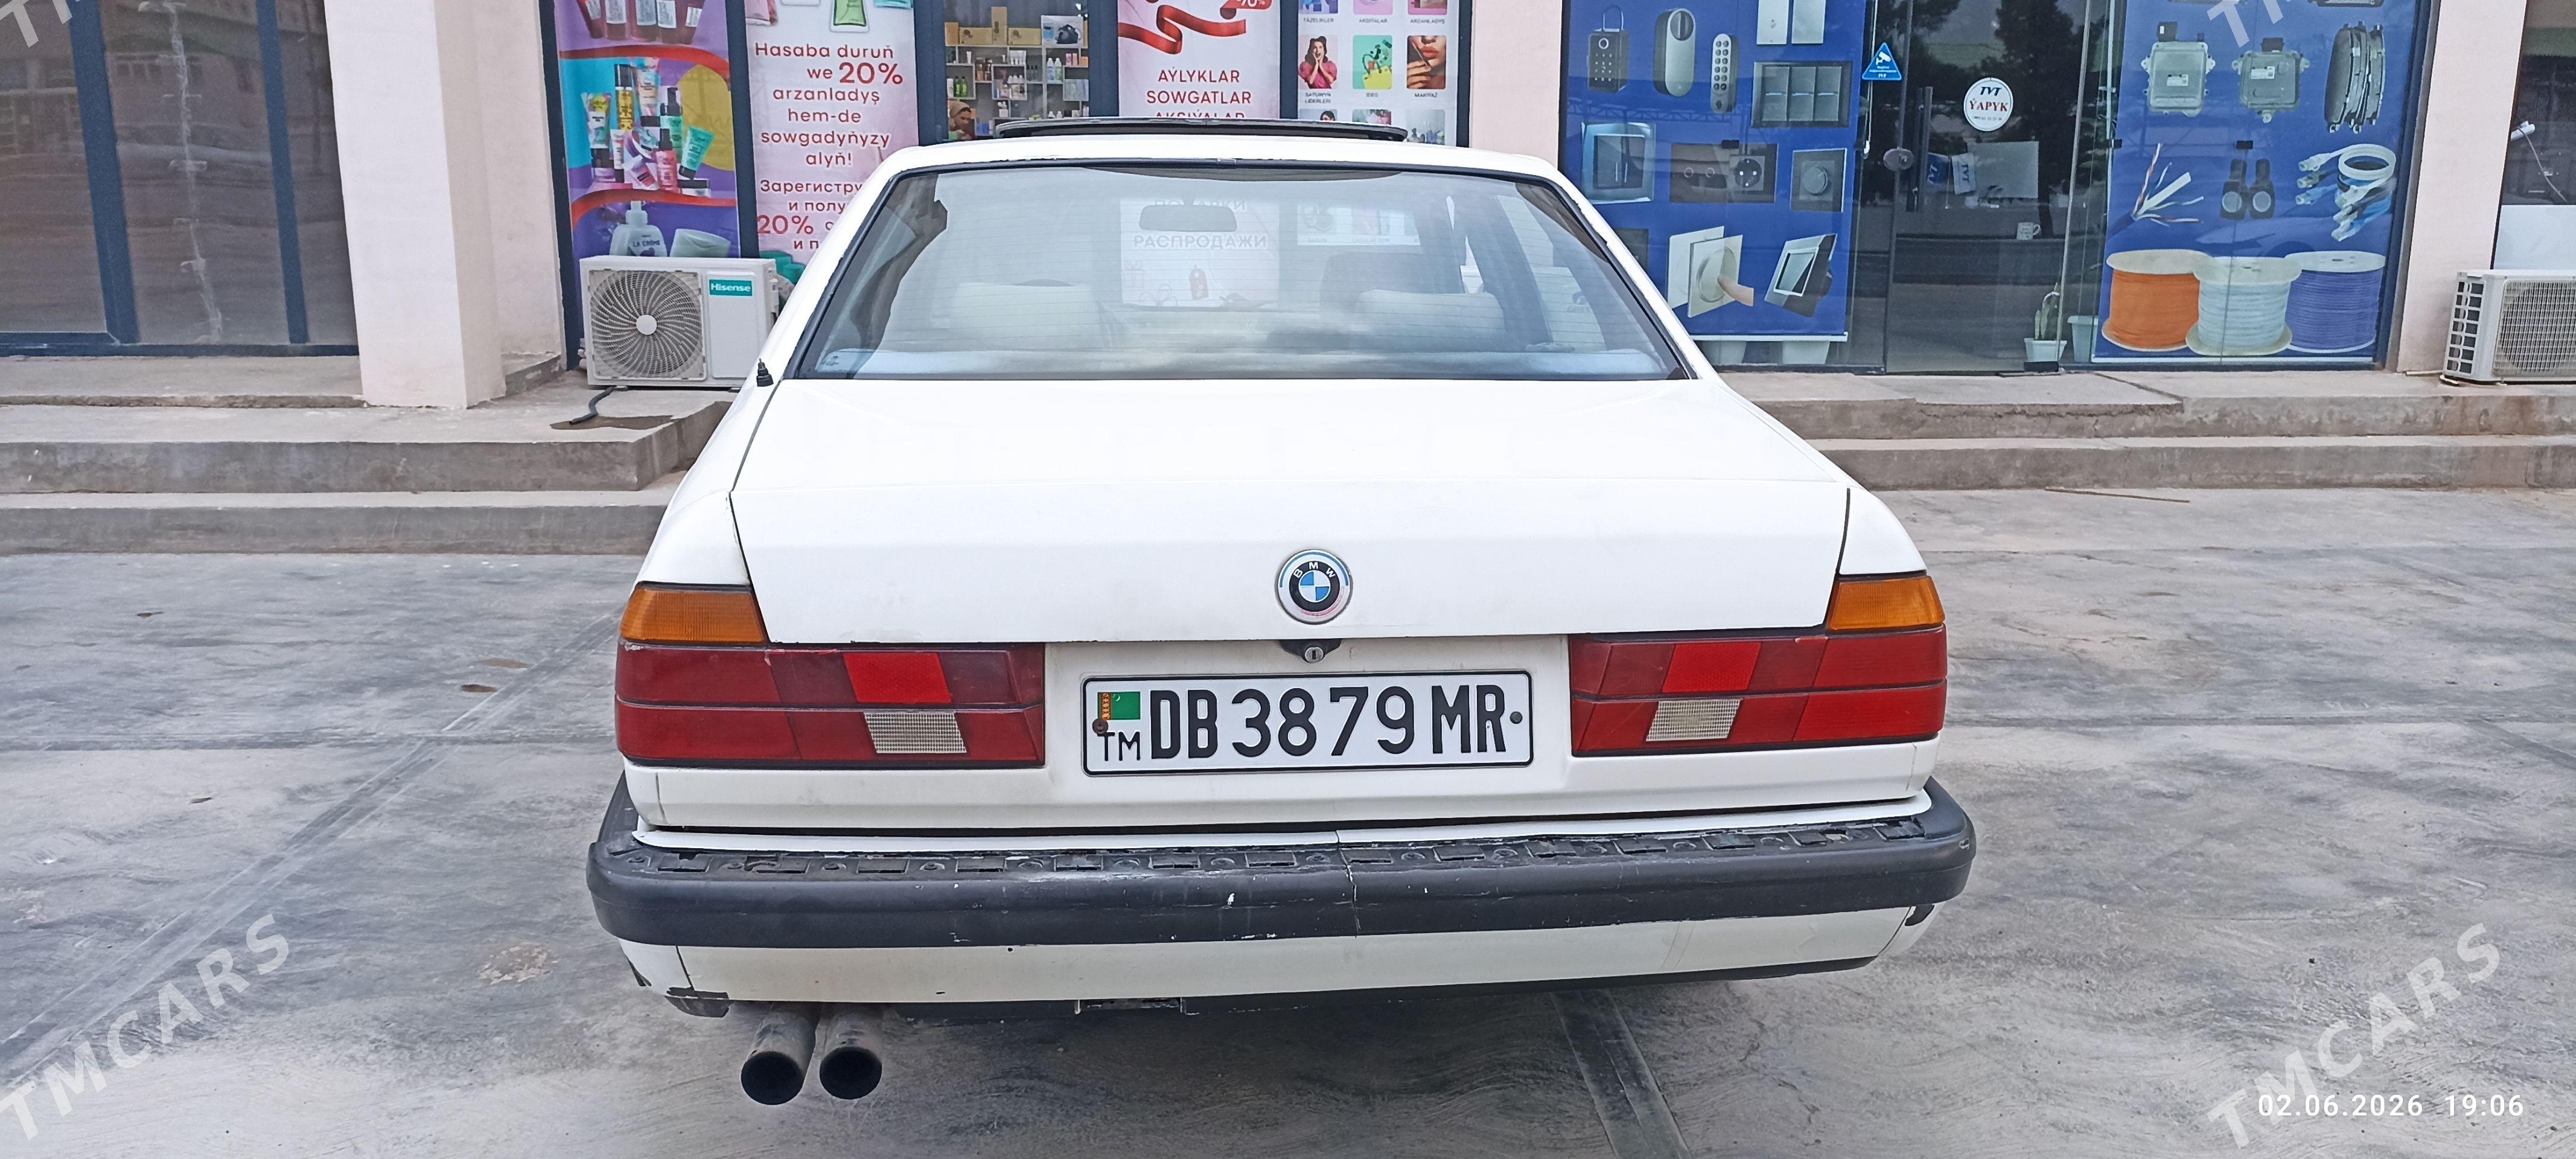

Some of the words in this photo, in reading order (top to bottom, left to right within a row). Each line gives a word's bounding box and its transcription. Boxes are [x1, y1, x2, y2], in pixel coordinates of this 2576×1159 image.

[755, 42, 830, 57] Hasaba
[837, 45, 893, 59] duruň
[807, 68, 833, 79] we
[839, 62, 903, 85] 20%
[773, 88, 880, 105] arzanladyş
[1147, 91, 1251, 104] SOWGATLAR
[1980, 86, 2002, 96] TVT
[788, 108, 861, 123] hem-de
[761, 130, 889, 148] sowgadyňyzy
[806, 152, 851, 168] alyň!
[789, 202, 798, 211] и
[805, 202, 849, 214] полу
[757, 214, 814, 235] 20%
[794, 240, 803, 249] и
[1133, 235, 1267, 250] РАСПРОДАЖИ
[710, 283, 751, 292] Hisense
[1293, 561, 1336, 578] BMW
[1097, 731, 1141, 762] TM
[1150, 689, 1218, 759] DB
[1231, 686, 1416, 757] 3879
[1431, 684, 1506, 754] MR
